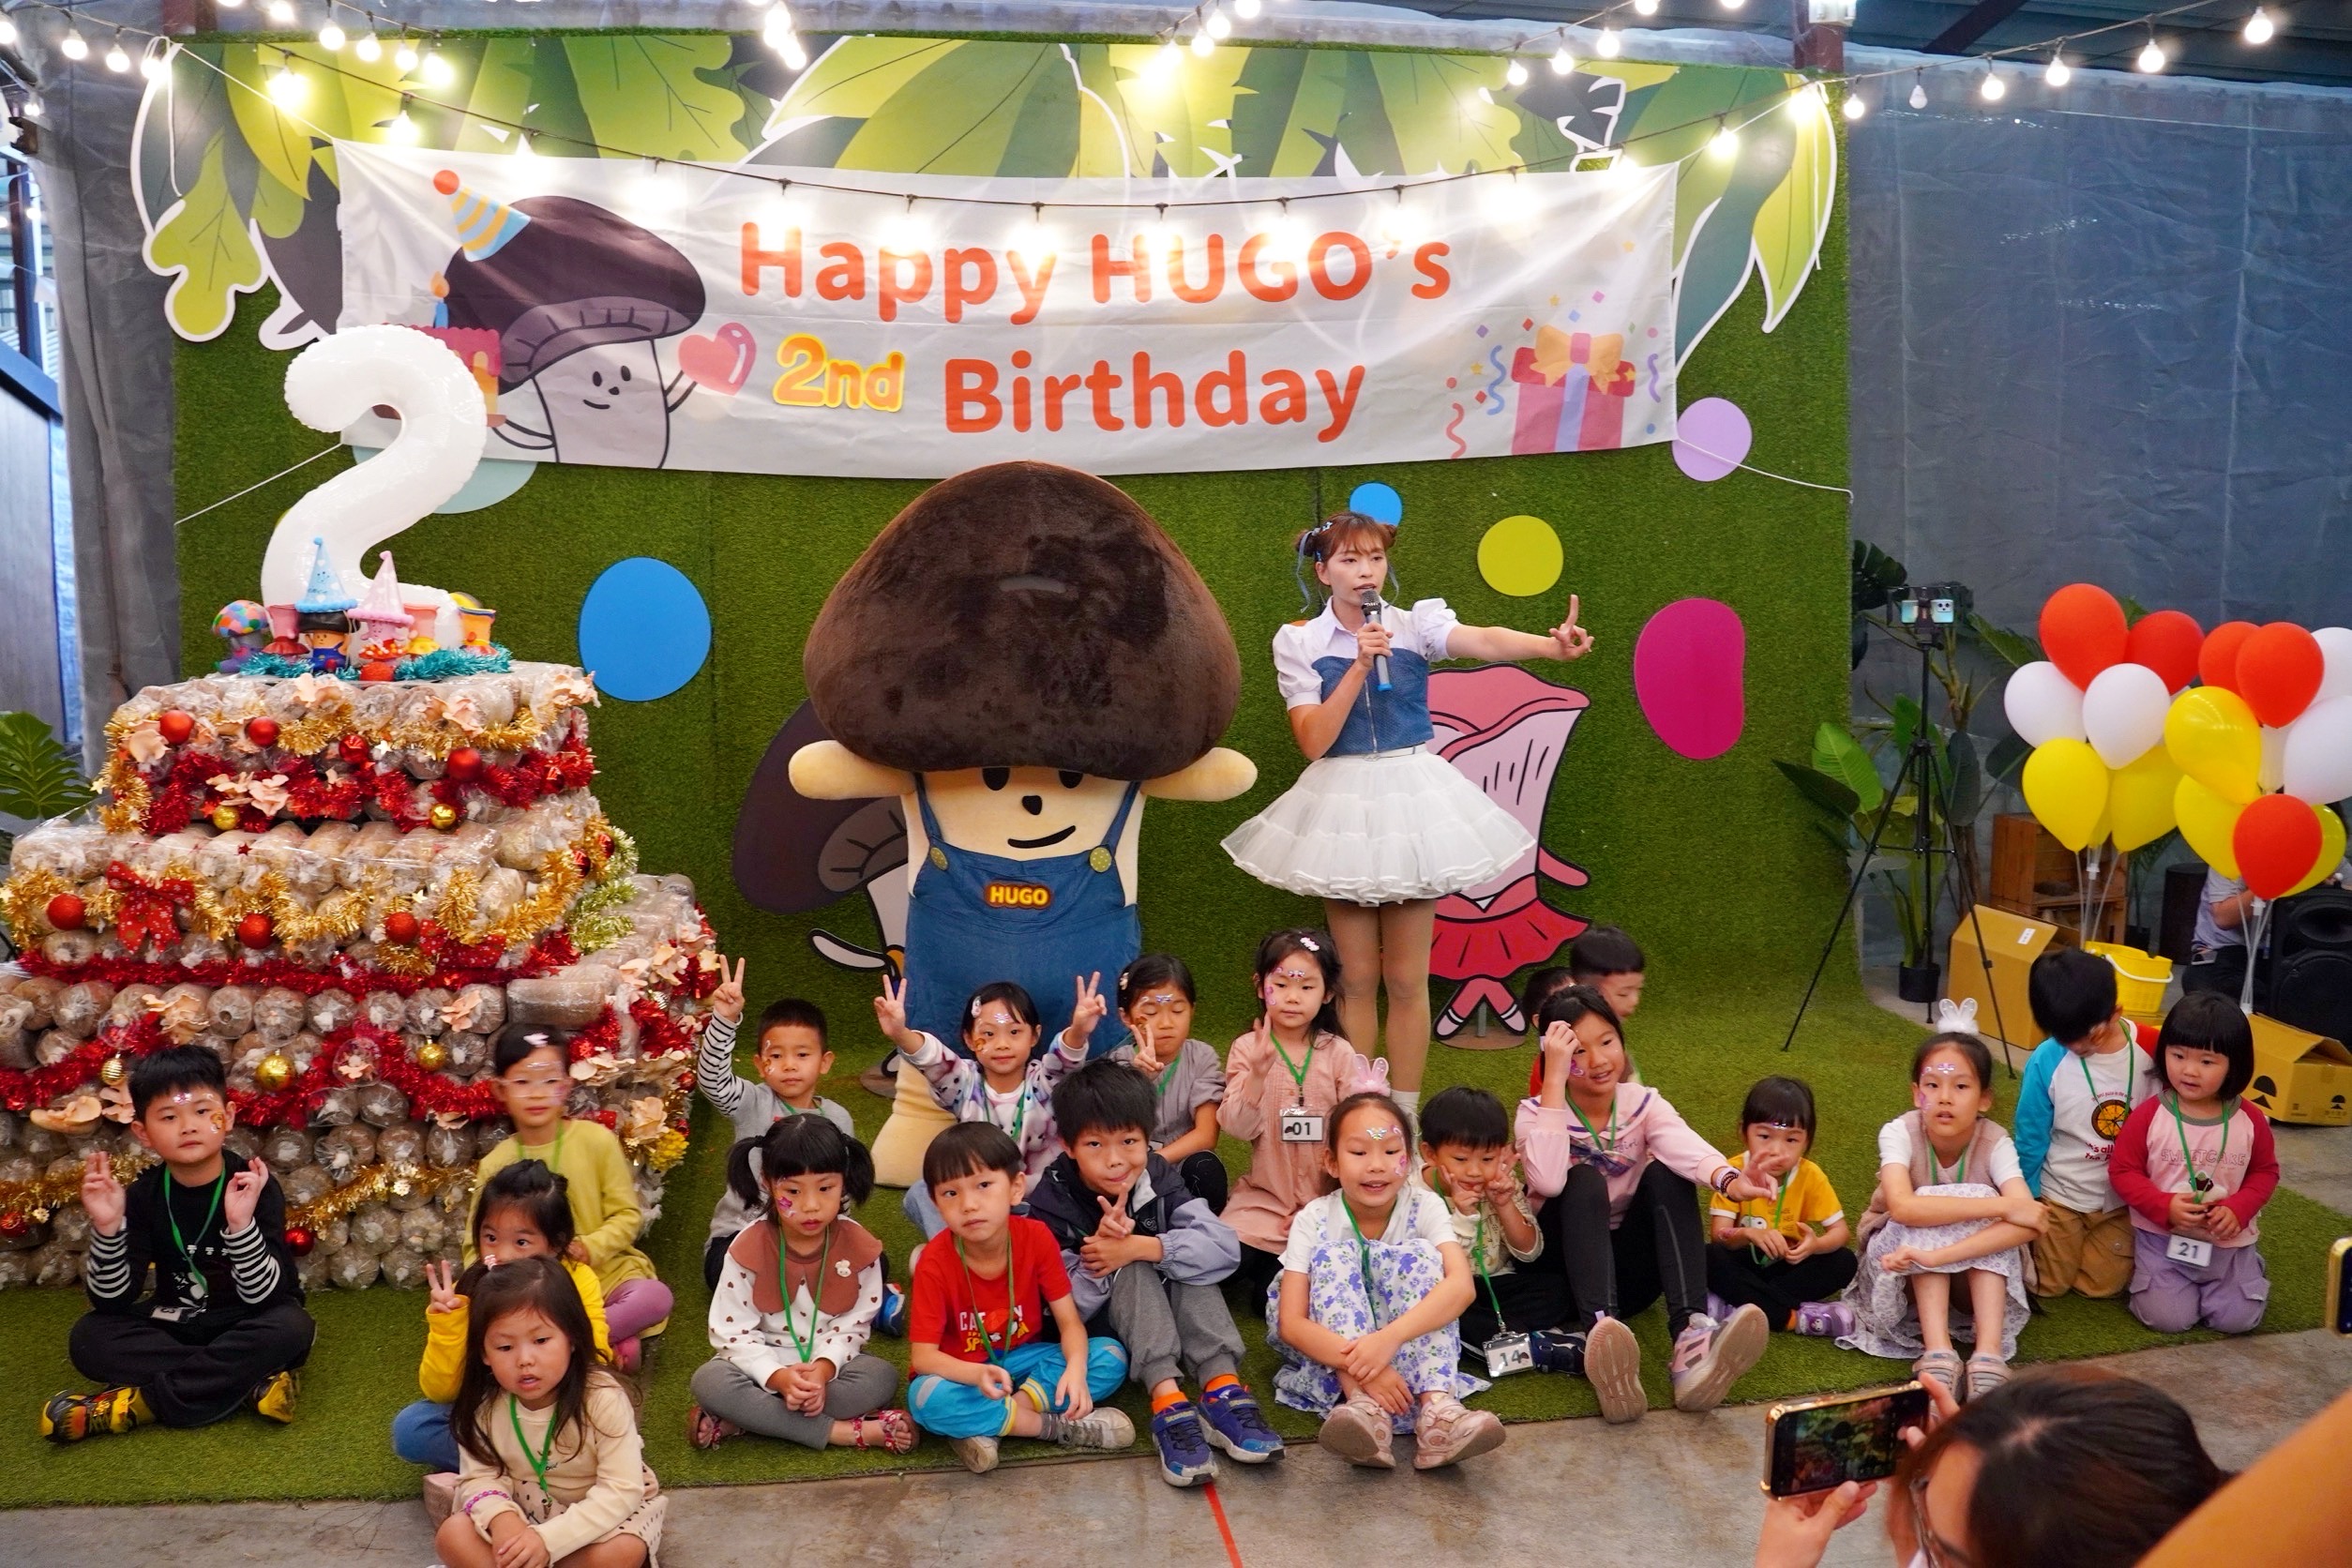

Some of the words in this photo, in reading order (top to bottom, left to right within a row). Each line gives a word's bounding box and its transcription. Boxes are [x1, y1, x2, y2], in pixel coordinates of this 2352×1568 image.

[740, 221, 1056, 325] Happy
[1091, 229, 1452, 305] HUGO's
[773, 333, 906, 414] 2nd
[945, 349, 1366, 444] Birthday
[989, 885, 1048, 906] HUGO
[1292, 1122, 1311, 1136] 01
[2177, 1242, 2199, 1259] 21
[1500, 1350, 1521, 1366] 14
